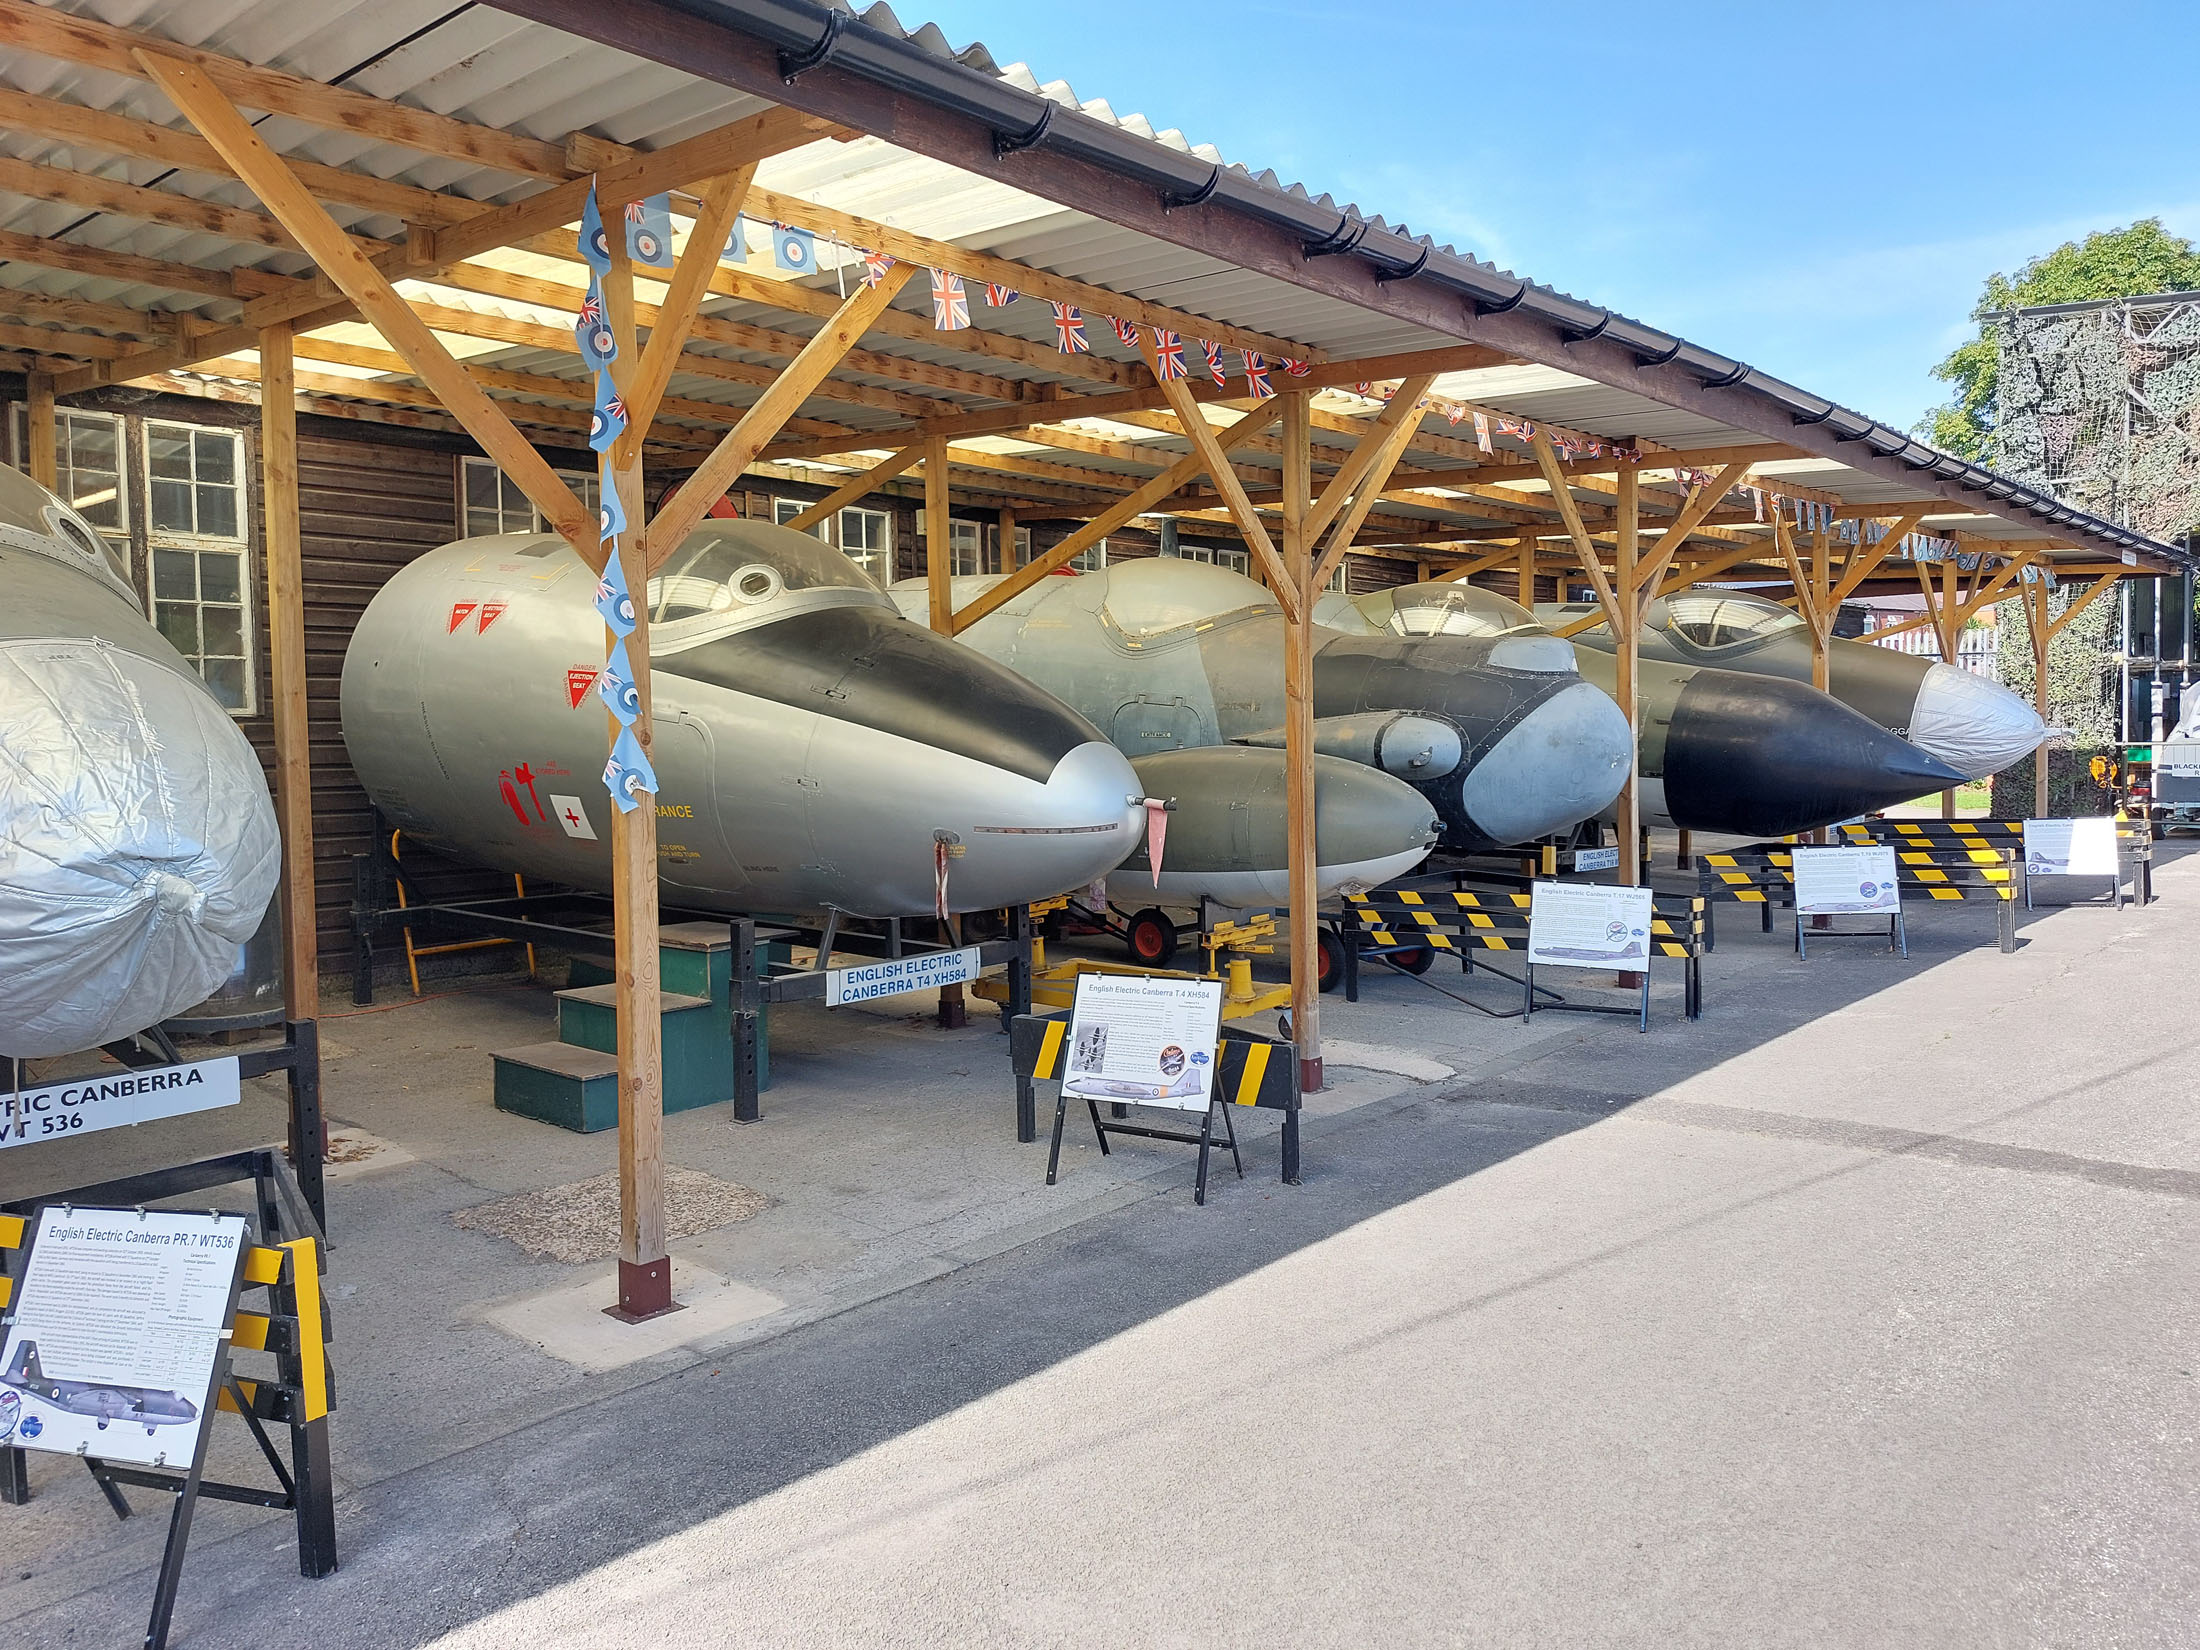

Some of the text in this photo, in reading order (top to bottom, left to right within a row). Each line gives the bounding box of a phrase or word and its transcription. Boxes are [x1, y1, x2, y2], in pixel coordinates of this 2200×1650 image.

[655, 805, 694, 818] RANCE
[1578, 860, 1606, 870] CANBERRA
[1583, 851, 1604, 861] ENGLISH
[1541, 888, 1563, 896] English
[1586, 890, 1612, 898] Canberra
[847, 953, 962, 985] ENGLISH ELECTRIC
[842, 968, 967, 1002] CANBERRA T4 XH584
[1088, 984, 1210, 999] English Electric Canberra T.4 XH584
[0, 1067, 204, 1117] RIC CANBERRA
[42, 1111, 84, 1135] 536
[49, 1225, 235, 1249] English Electric Canberra PR.7 WT536
